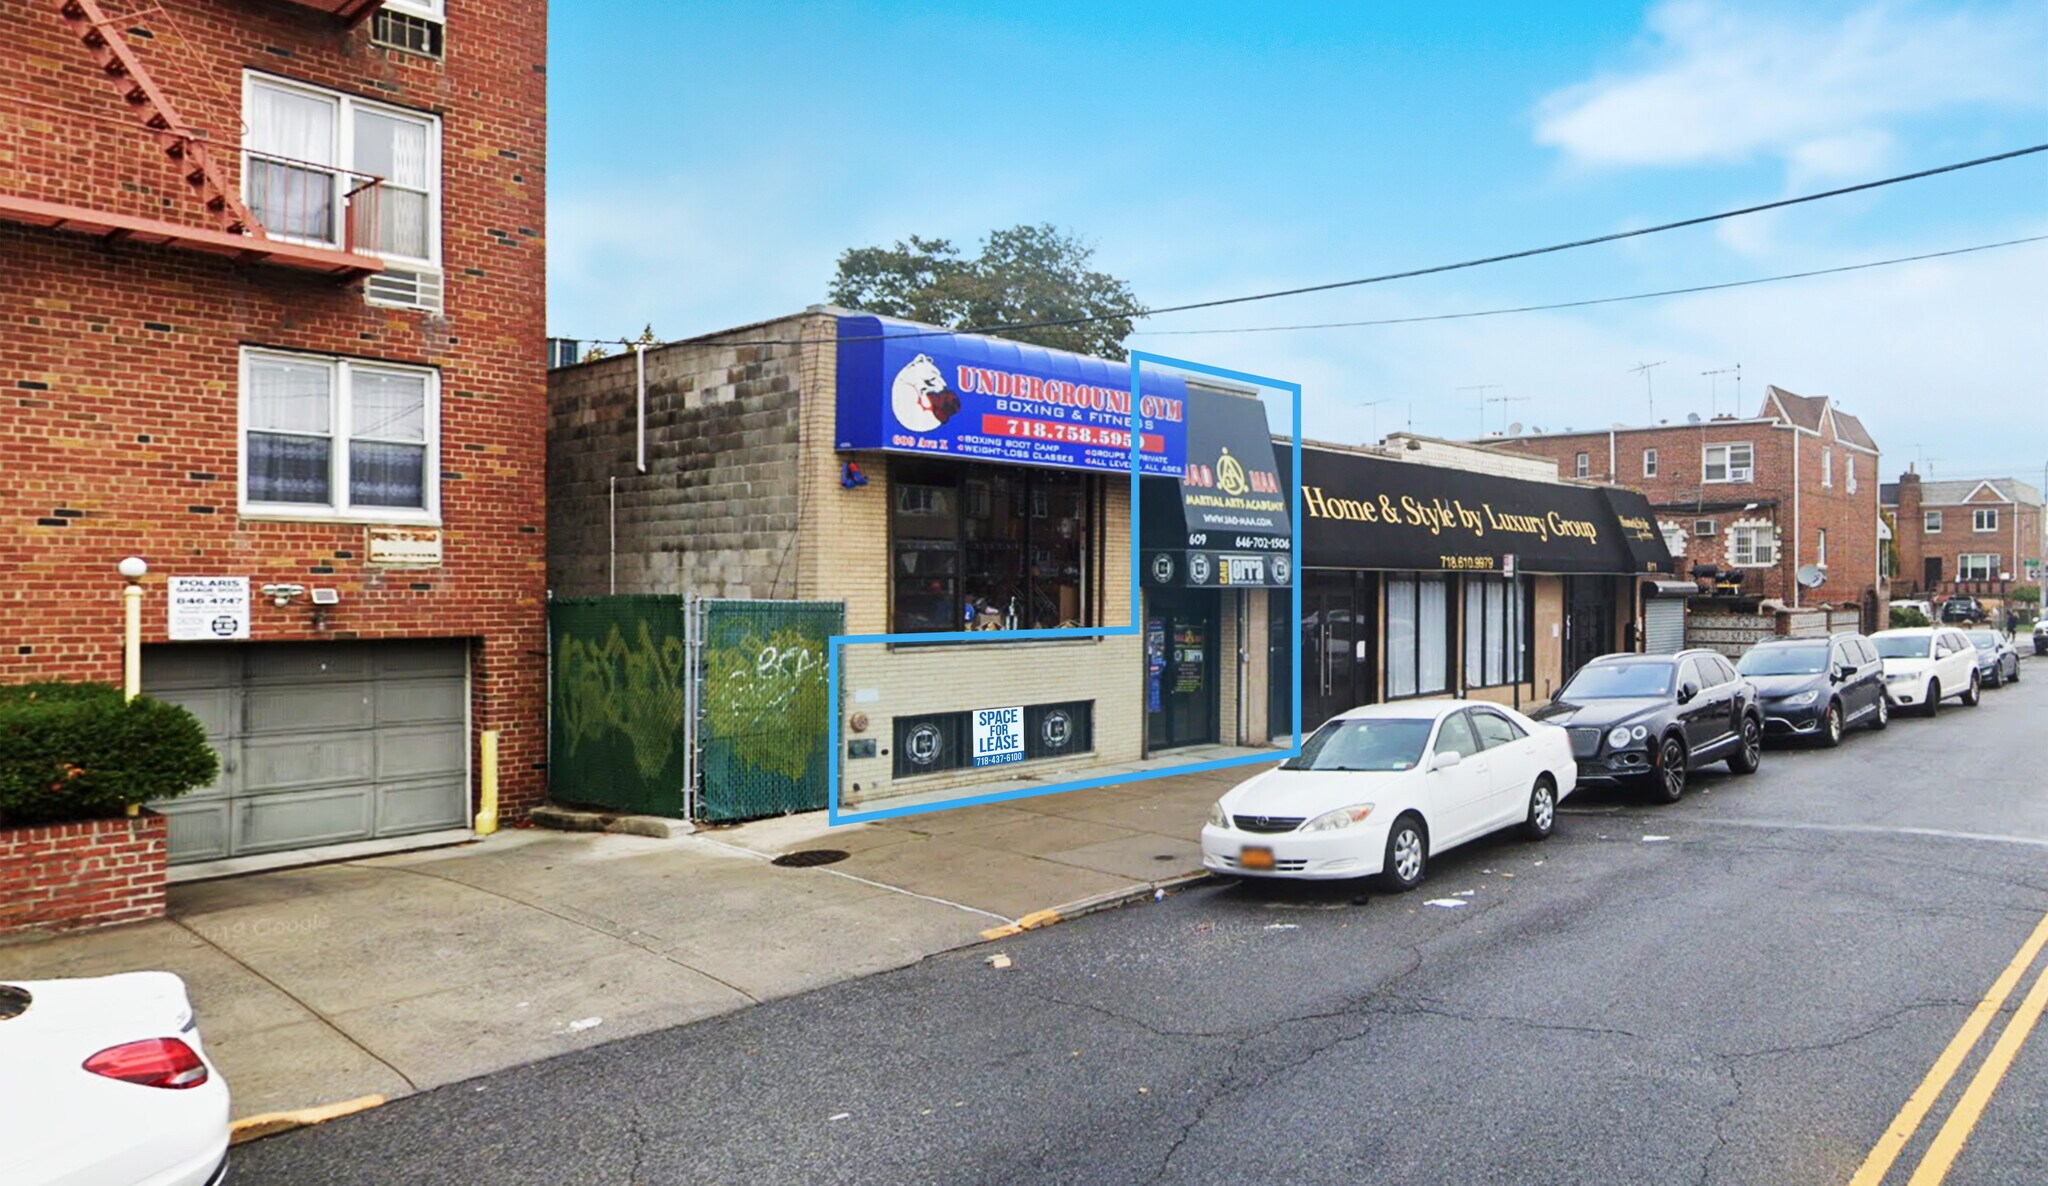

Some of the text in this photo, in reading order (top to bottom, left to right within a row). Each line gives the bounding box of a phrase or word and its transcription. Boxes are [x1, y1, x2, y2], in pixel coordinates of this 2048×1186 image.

[996, 399, 1065, 418] BOXING
[1071, 410, 1082, 421] &
[1139, 394, 1183, 422] GYM
[964, 435, 1060, 452] BOXING BOOT CAMP
[964, 444, 1074, 463] WEIGHT-LOSS CLASSES
[1091, 449, 1126, 460] GROUPS
[1091, 458, 1107, 466] ALL
[1144, 463, 1159, 471] ALL
[1248, 470, 1279, 493] MAA
[1186, 494, 1284, 512] MARTIAL ARTS ACADEMY
[1301, 485, 1598, 545] Home & Style by Luxury Group
[1188, 533, 1207, 546] 609
[1235, 536, 1290, 549] 646-702-1506
[1219, 555, 1264, 585] Terra
[1440, 556, 1494, 569] 718.610.9979
[979, 709, 1018, 726] SPACE
[990, 724, 1008, 736] FOR
[979, 734, 1019, 752] LEASE
[976, 752, 1022, 766] 718-437-6100
